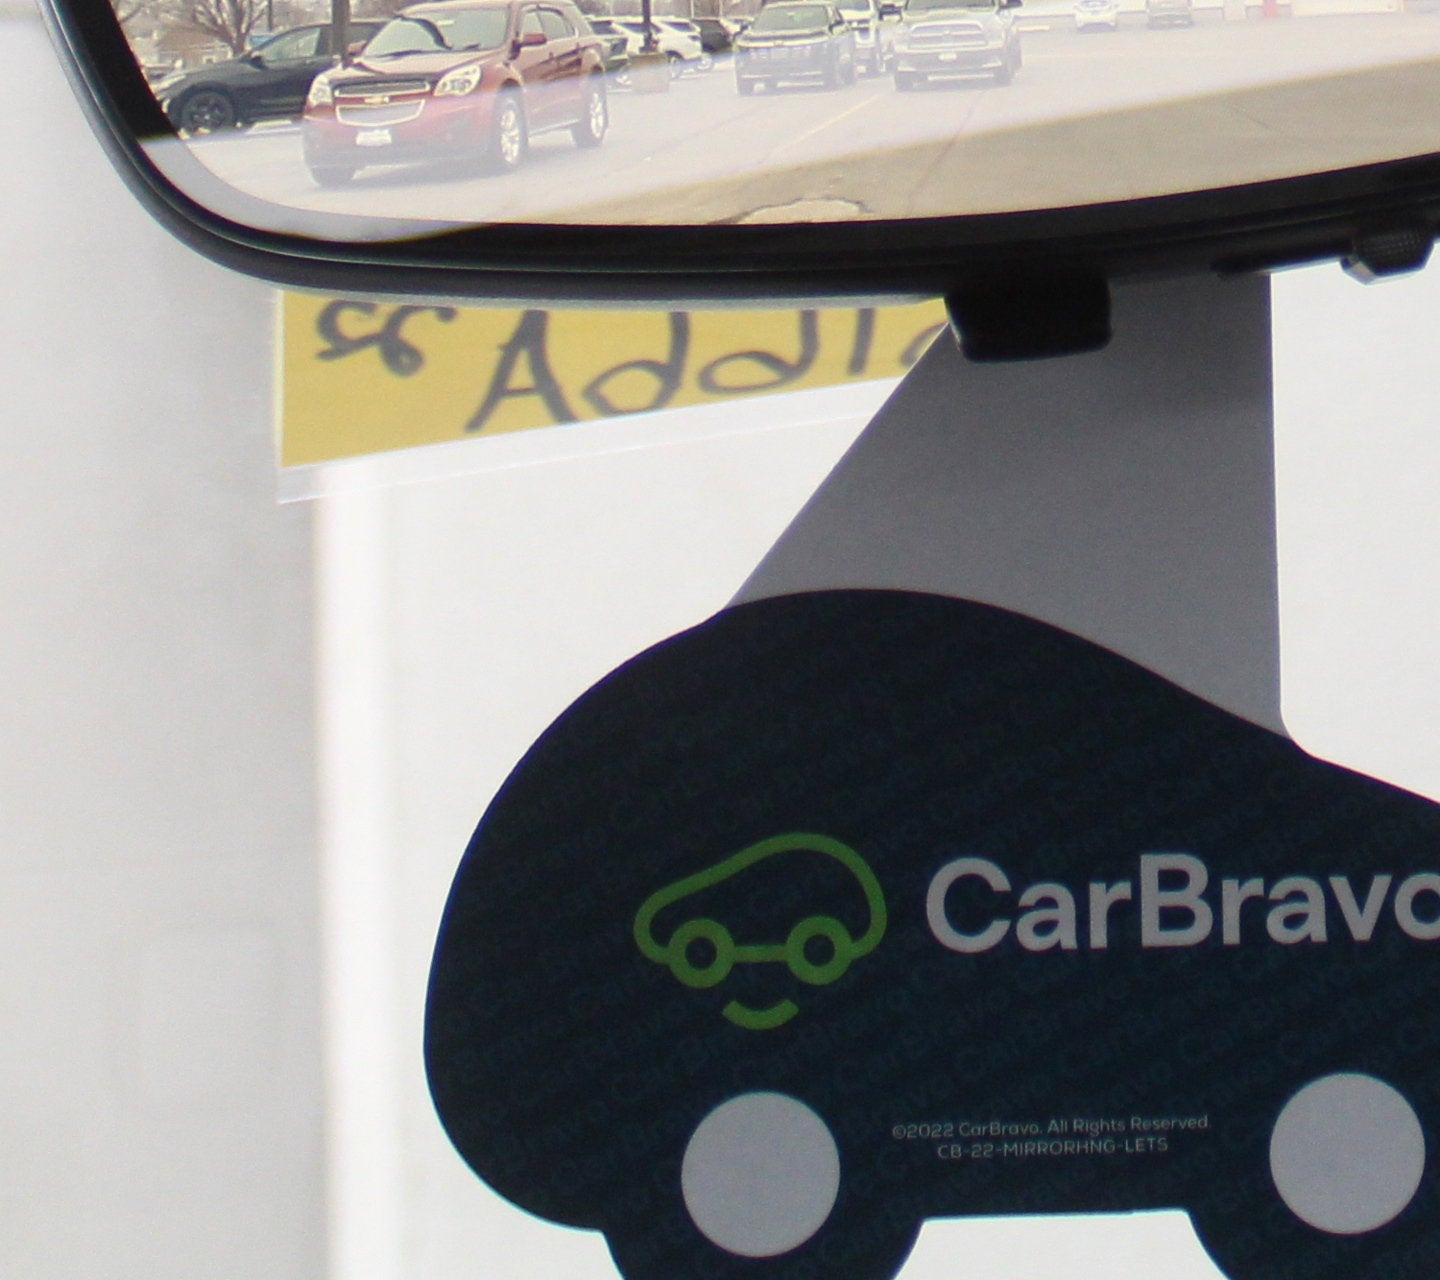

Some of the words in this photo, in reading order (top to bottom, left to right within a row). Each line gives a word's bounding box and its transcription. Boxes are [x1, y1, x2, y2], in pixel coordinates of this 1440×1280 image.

[959, 1120, 1043, 1137] CarBravo.
[1047, 1118, 1068, 1134] All
[1073, 1117, 1126, 1138] Rights
